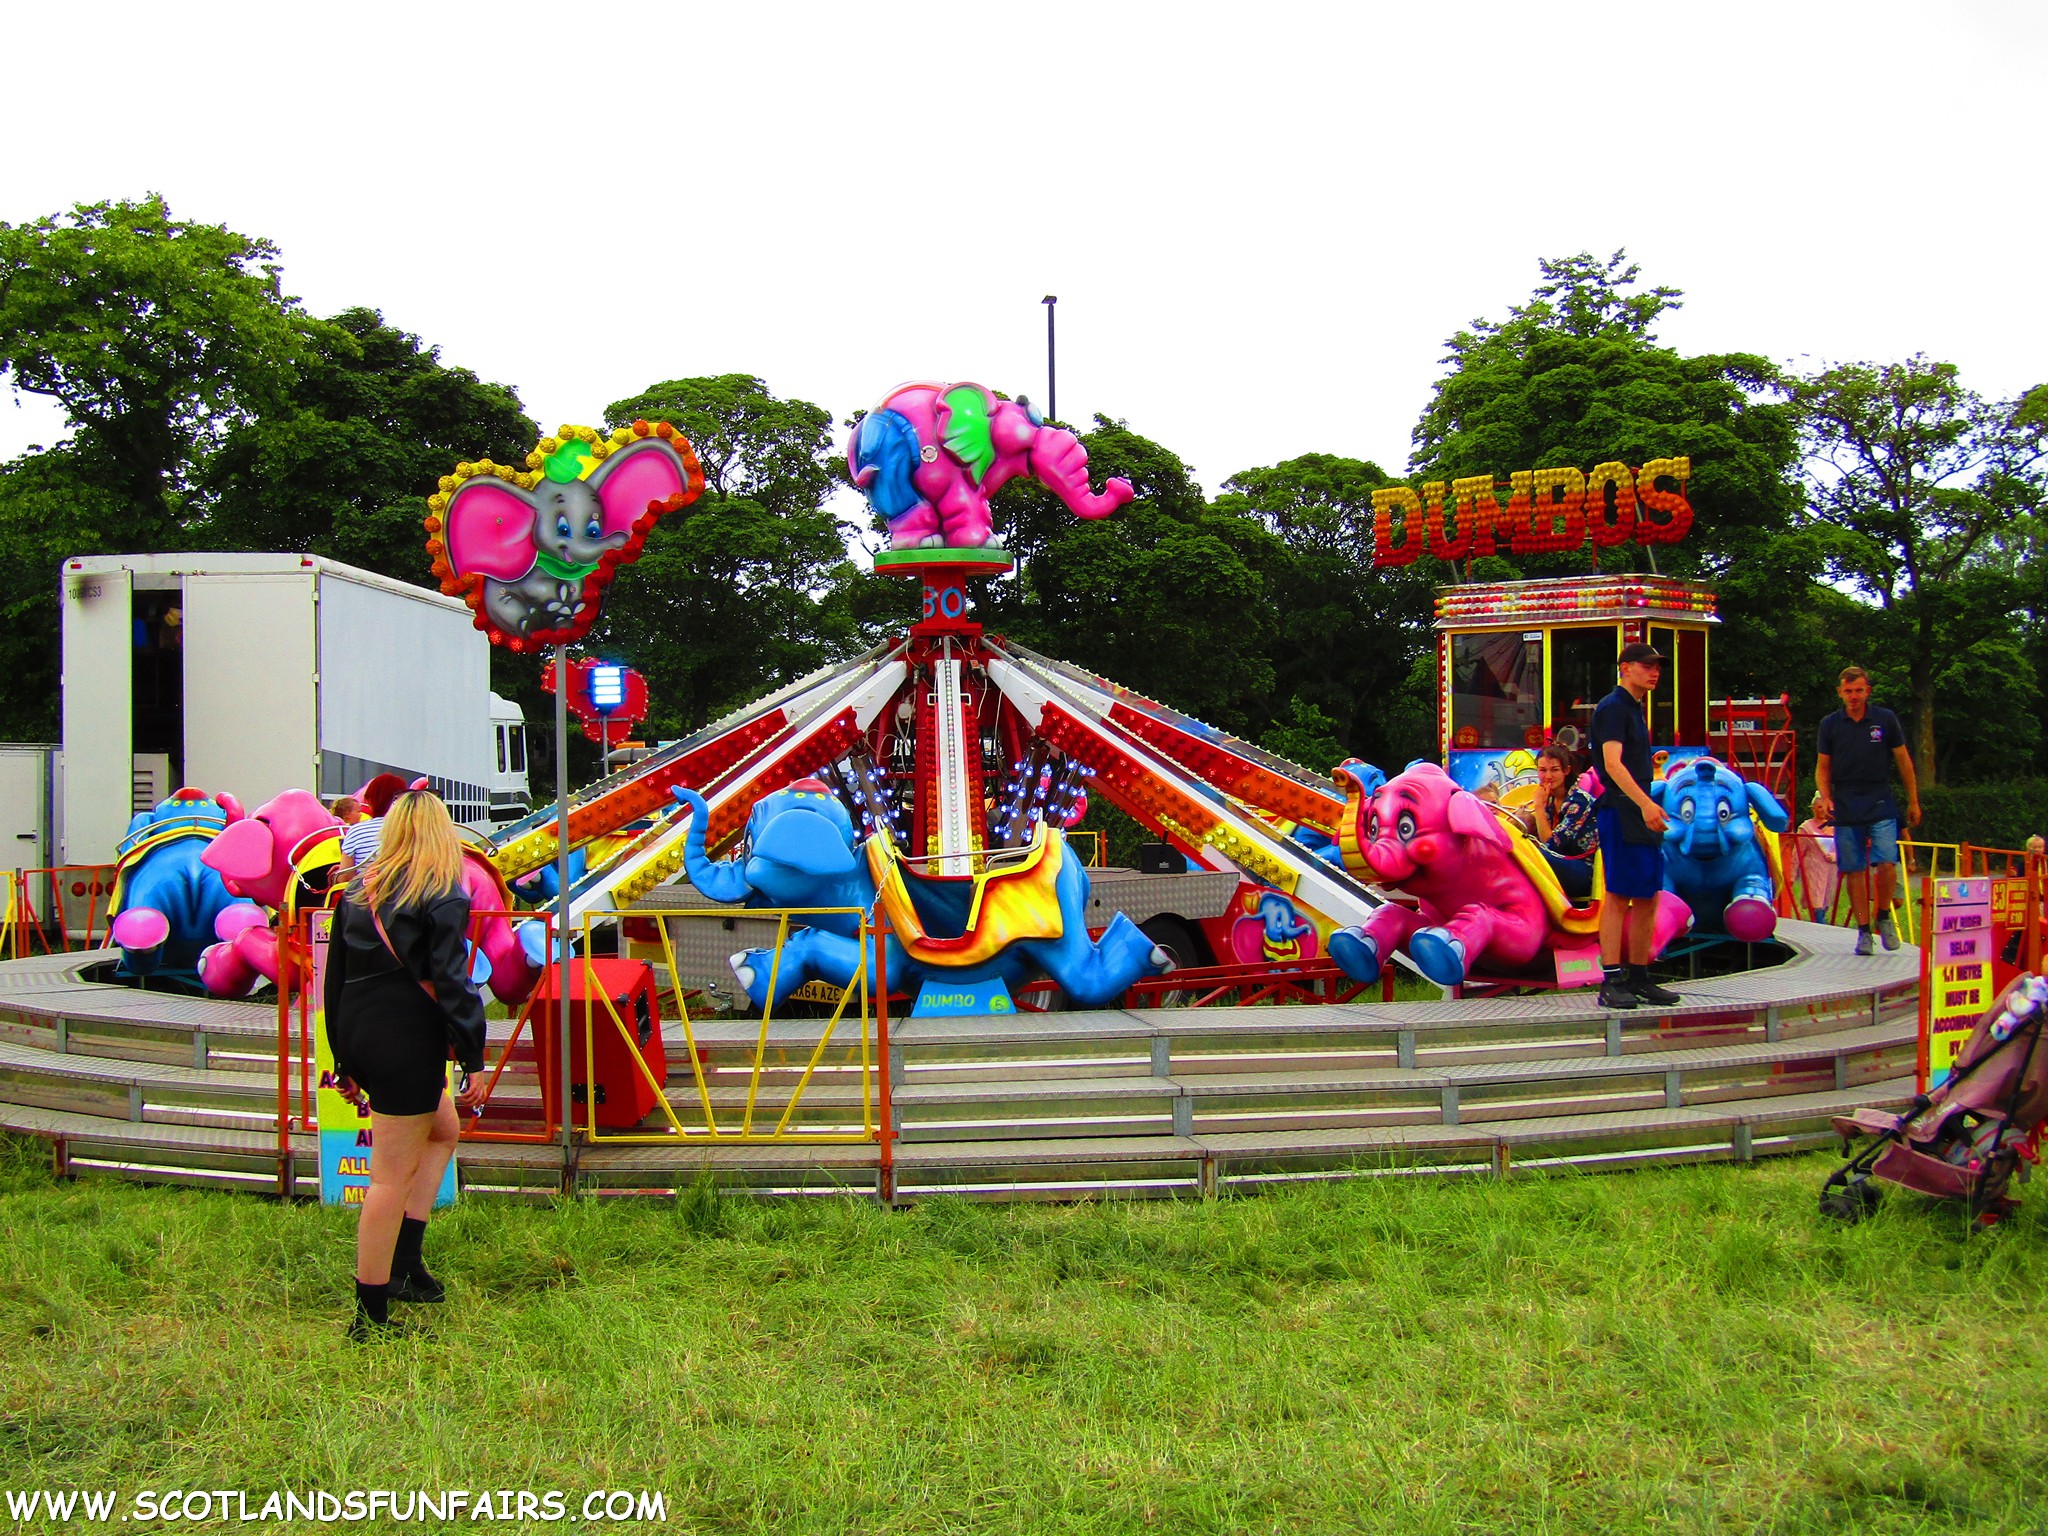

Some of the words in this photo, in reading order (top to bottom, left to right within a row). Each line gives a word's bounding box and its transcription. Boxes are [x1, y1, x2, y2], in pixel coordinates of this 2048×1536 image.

[1371, 456, 1694, 567] DUMBOS
[1942, 916, 1959, 932] ANY
[1960, 915, 1983, 928] RIDER
[1950, 940, 1976, 957] BELOW
[1943, 966, 1954, 982] 1.1
[1956, 963, 1982, 981] METRE
[921, 994, 975, 1008] DUMBO
[1945, 990, 1968, 1007] MUST
[1969, 988, 1980, 1004] BE
[337, 1157, 370, 1176] ALL
